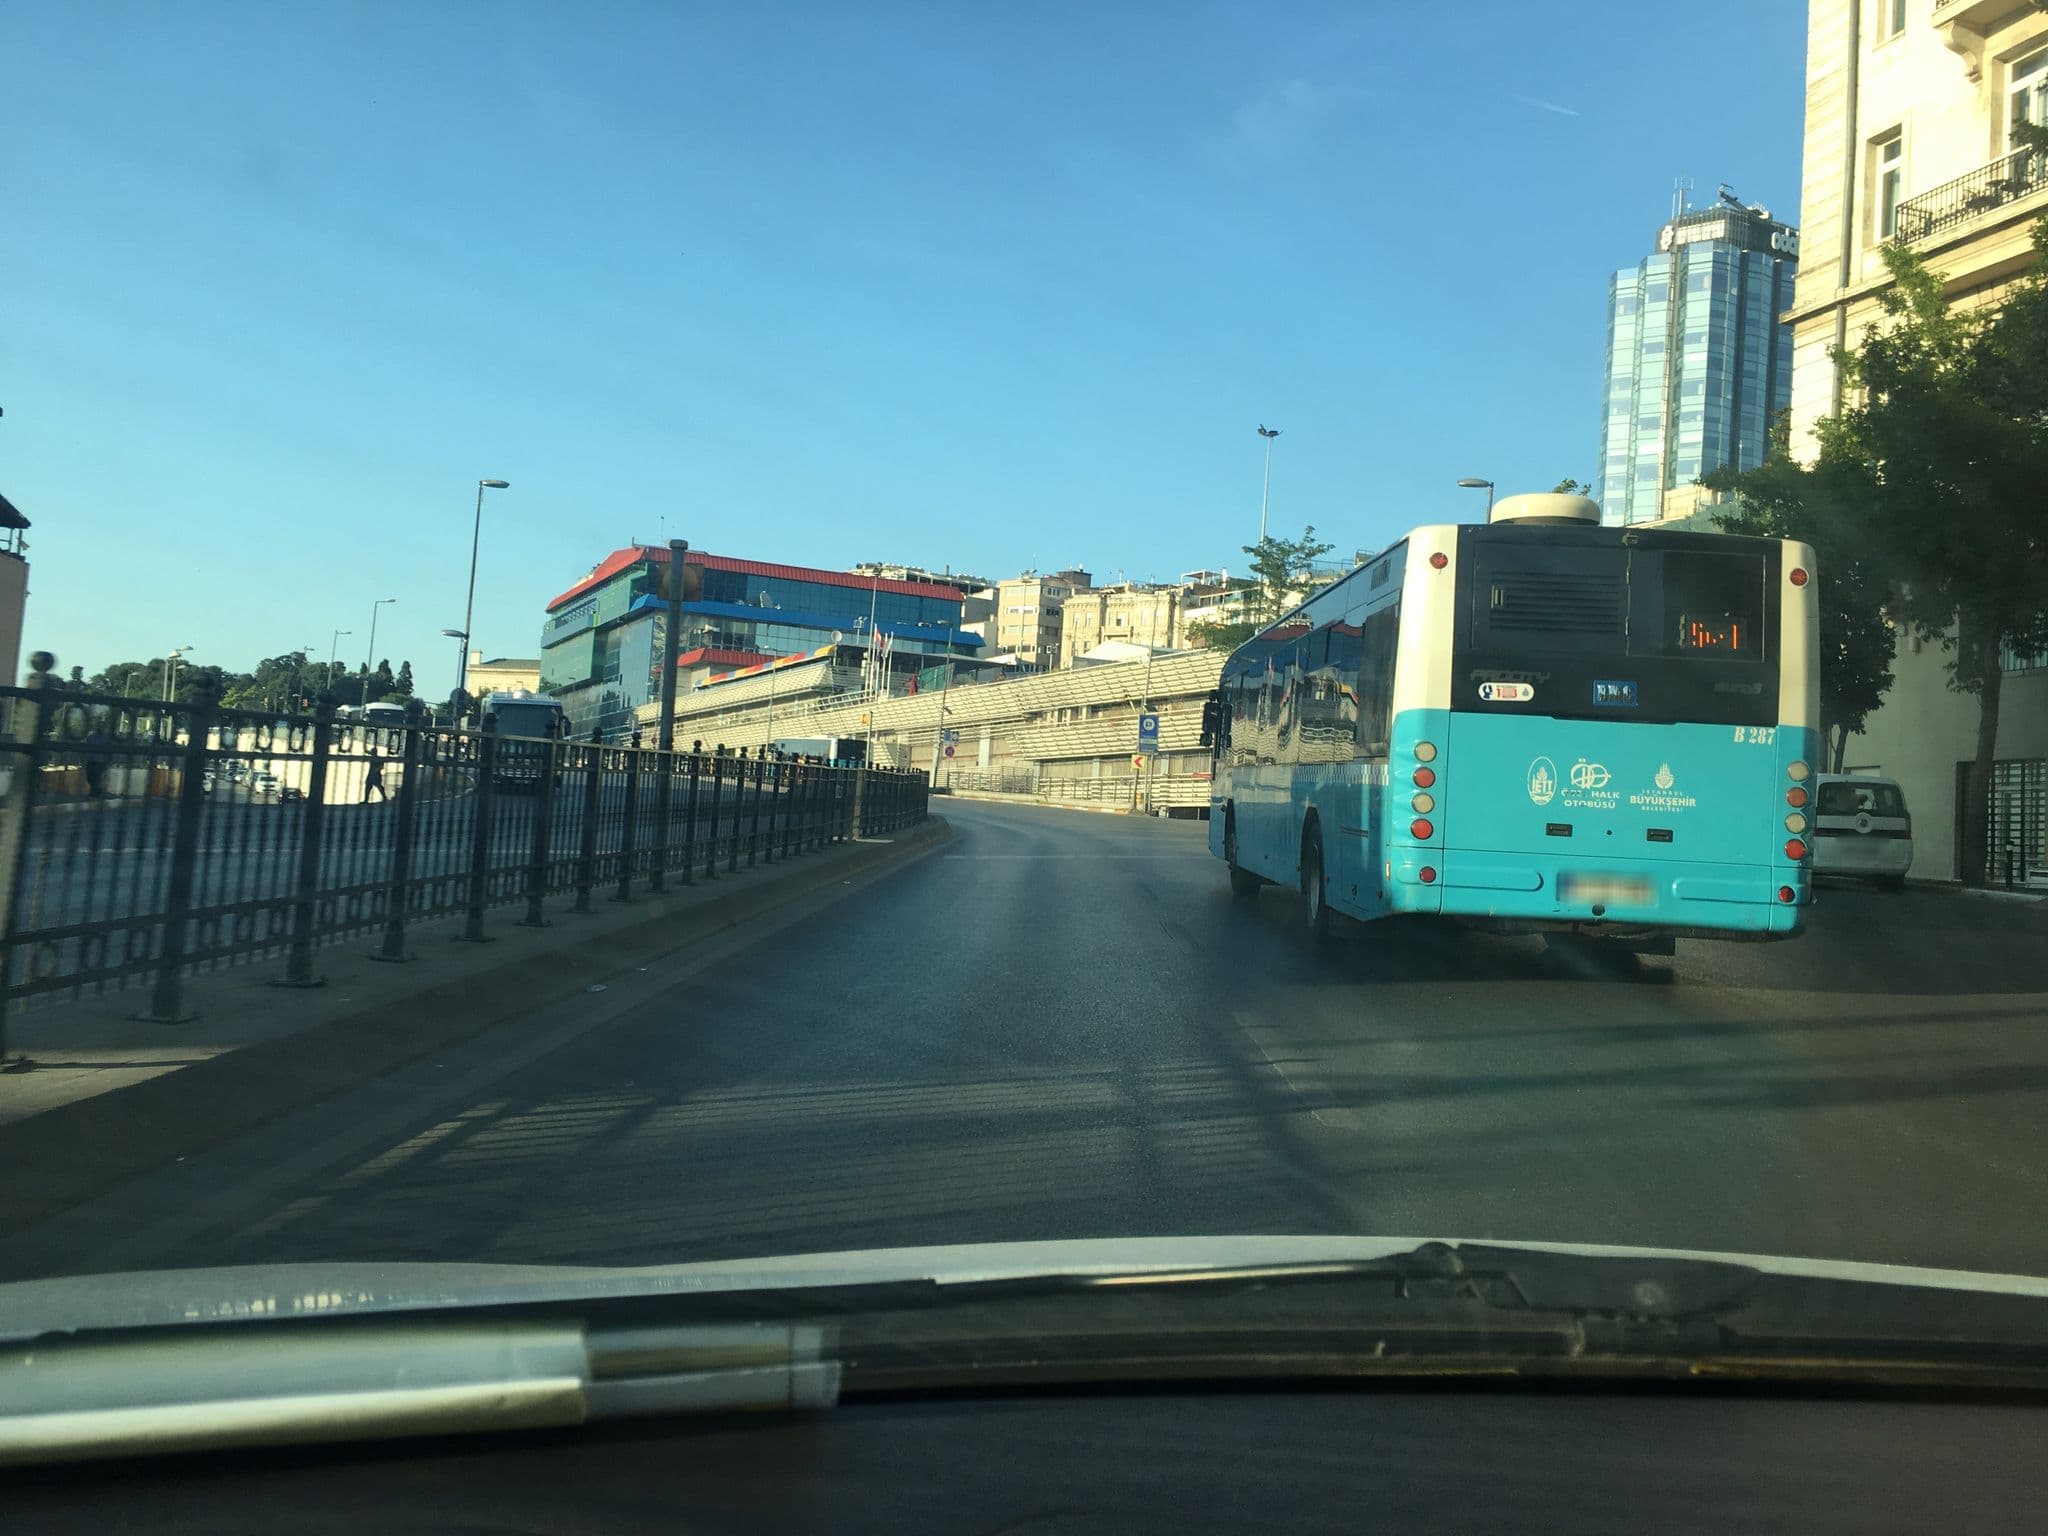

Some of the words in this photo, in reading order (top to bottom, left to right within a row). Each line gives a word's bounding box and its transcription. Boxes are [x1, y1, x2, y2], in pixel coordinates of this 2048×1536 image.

[1734, 727, 1745, 743] B
[1749, 727, 1776, 744] 287
[1591, 790, 1620, 799] HALK
[1563, 798, 1616, 809] OTOBÜSÜ
[1630, 794, 1697, 808] BÜYÜKŞEHİR
